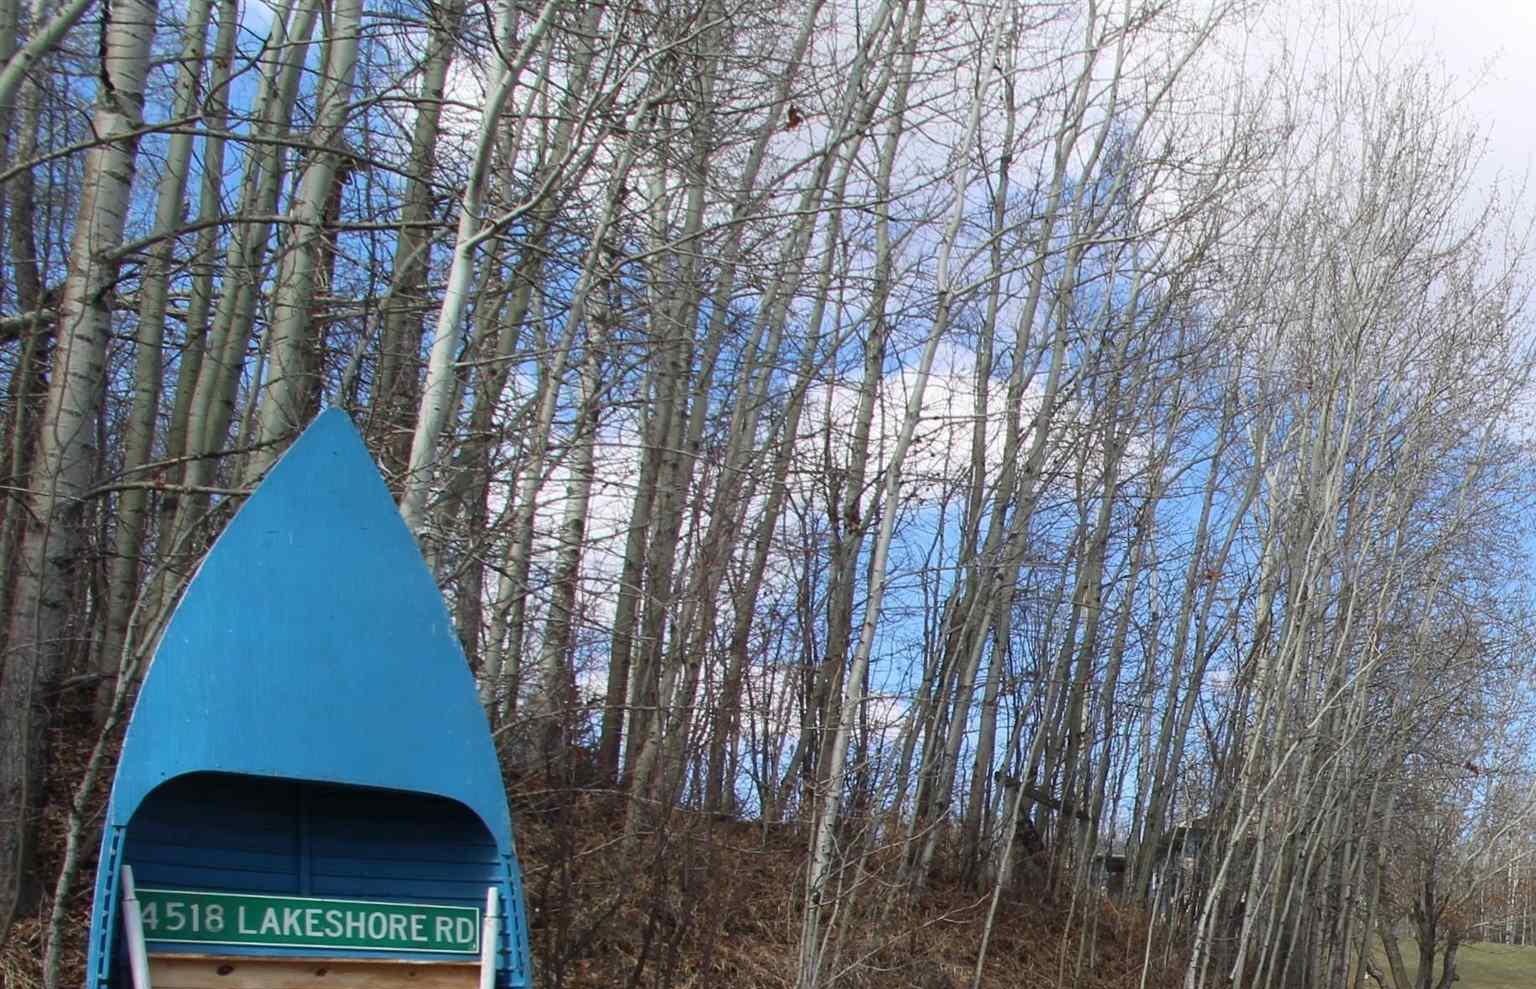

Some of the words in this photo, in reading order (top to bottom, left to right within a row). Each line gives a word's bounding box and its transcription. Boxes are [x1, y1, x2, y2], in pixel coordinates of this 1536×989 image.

[143, 902, 225, 932] 4518
[237, 904, 428, 943] LAKESHORE
[435, 916, 474, 943] RD
